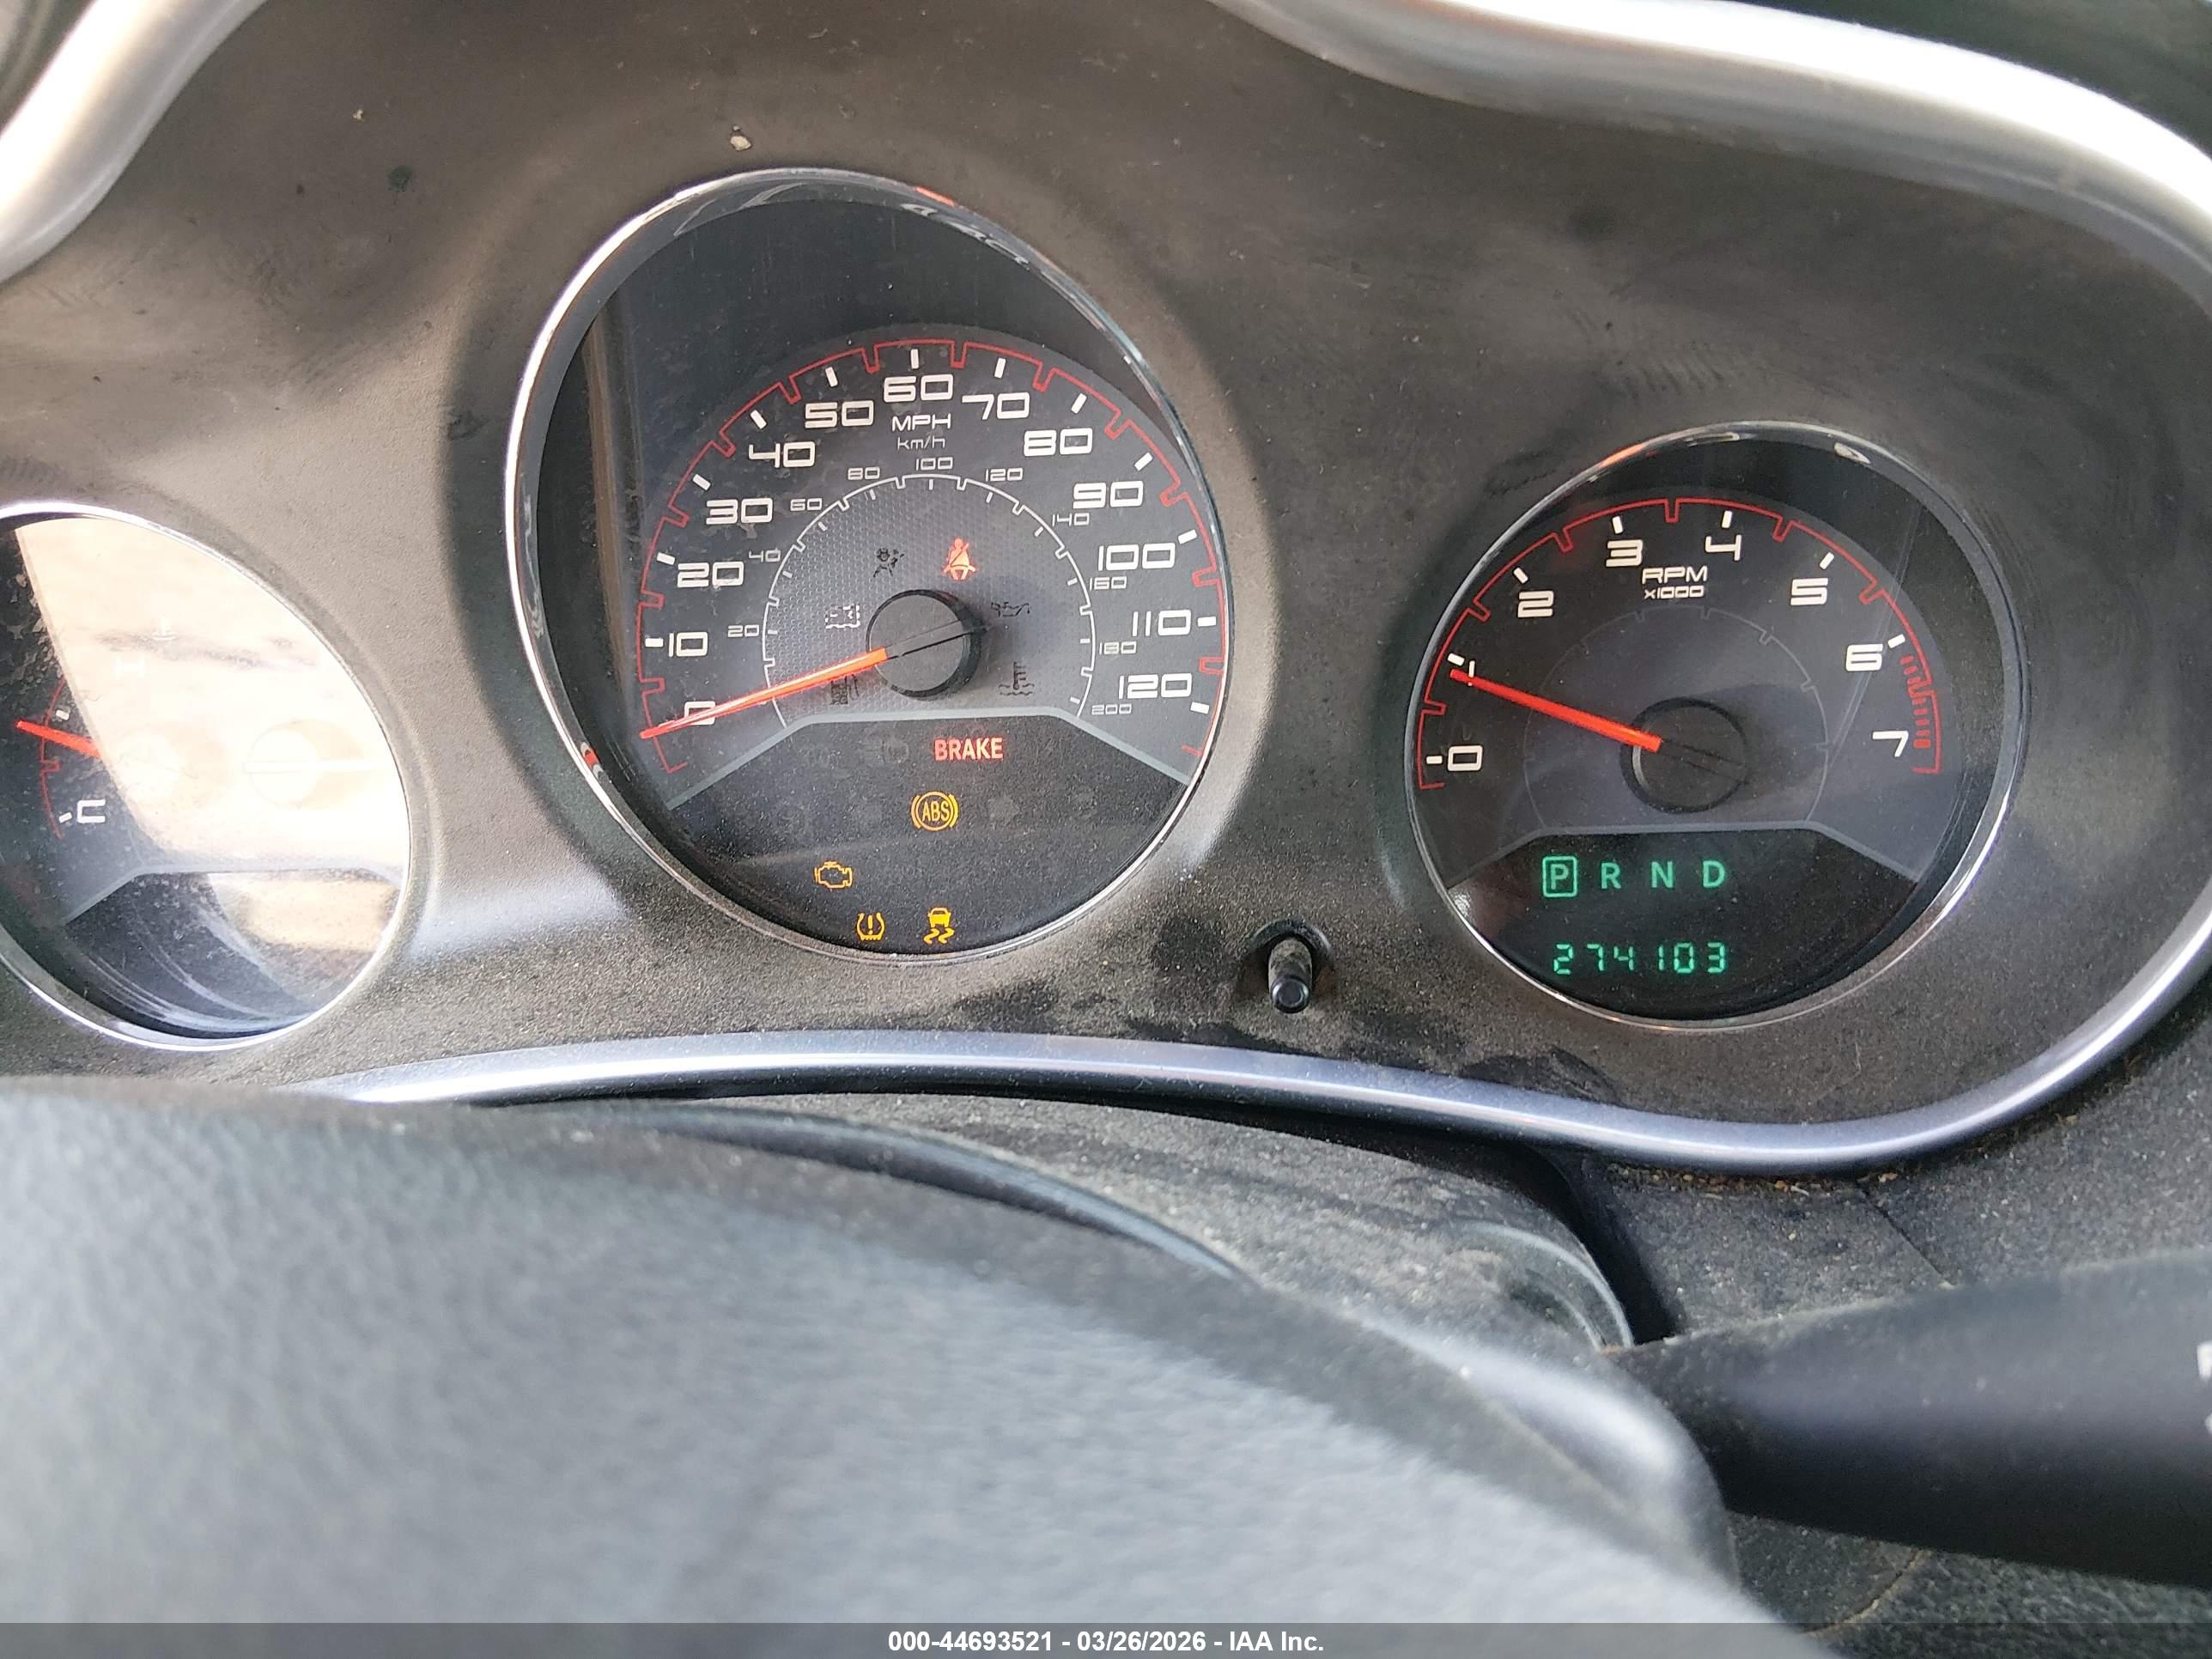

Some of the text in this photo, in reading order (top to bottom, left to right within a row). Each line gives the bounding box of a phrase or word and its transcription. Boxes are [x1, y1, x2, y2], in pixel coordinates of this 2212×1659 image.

[884, 374, 953, 404] 60
[805, 400, 874, 429] 50
[962, 392, 1030, 420] 70
[891, 413, 951, 433] MPH
[748, 441, 816, 468] 40
[897, 435, 946, 451] km/h
[1024, 428, 1093, 457] 80
[848, 466, 881, 481] 80
[915, 457, 953, 471] 100
[985, 467, 1024, 482] 120
[790, 497, 823, 512] 60
[1073, 480, 1144, 509] 90
[706, 497, 773, 525] 30
[1052, 512, 1091, 526] 140
[748, 548, 781, 563] 40
[1097, 543, 1176, 572] 100
[1605, 539, 1644, 568] 3
[1705, 534, 1742, 562] 4
[677, 561, 744, 588] 20
[1089, 575, 1127, 591] 160
[1641, 565, 1708, 585] RPM
[1517, 590, 1554, 618] 2
[1643, 585, 1705, 600] x1000
[1790, 577, 1829, 606] 5
[727, 624, 760, 638] 20
[1132, 609, 1193, 637] 110
[668, 631, 708, 658] 10
[1099, 641, 1137, 655] 180
[1845, 643, 1884, 672] 6
[1118, 672, 1193, 699] 120
[1091, 702, 1132, 716] 200
[934, 738, 1004, 762] BRAKE
[1872, 731, 1909, 757] 7
[1447, 744, 1483, 772] 0
[76, 799, 106, 824] C
[921, 799, 951, 823] ABS
[1550, 860, 1726, 890] P R N D
[1553, 941, 1726, 975] 274103
